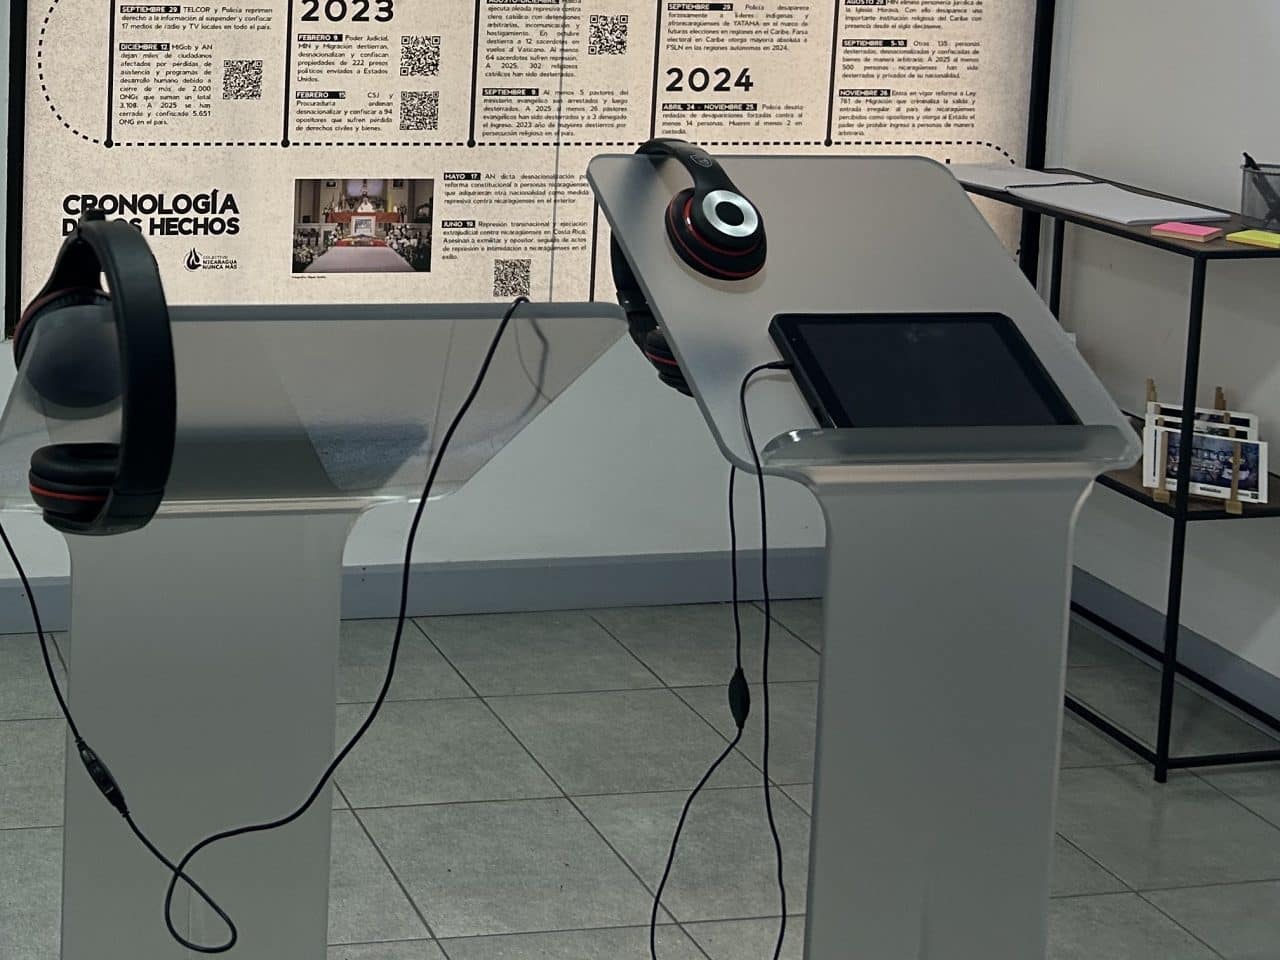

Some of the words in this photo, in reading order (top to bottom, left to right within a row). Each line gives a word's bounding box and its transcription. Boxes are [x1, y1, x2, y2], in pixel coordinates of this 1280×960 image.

[666, 67, 754, 92] 2024
[62, 189, 240, 215] CRONOLOGÍA
[149, 217, 240, 236] HECHOS
